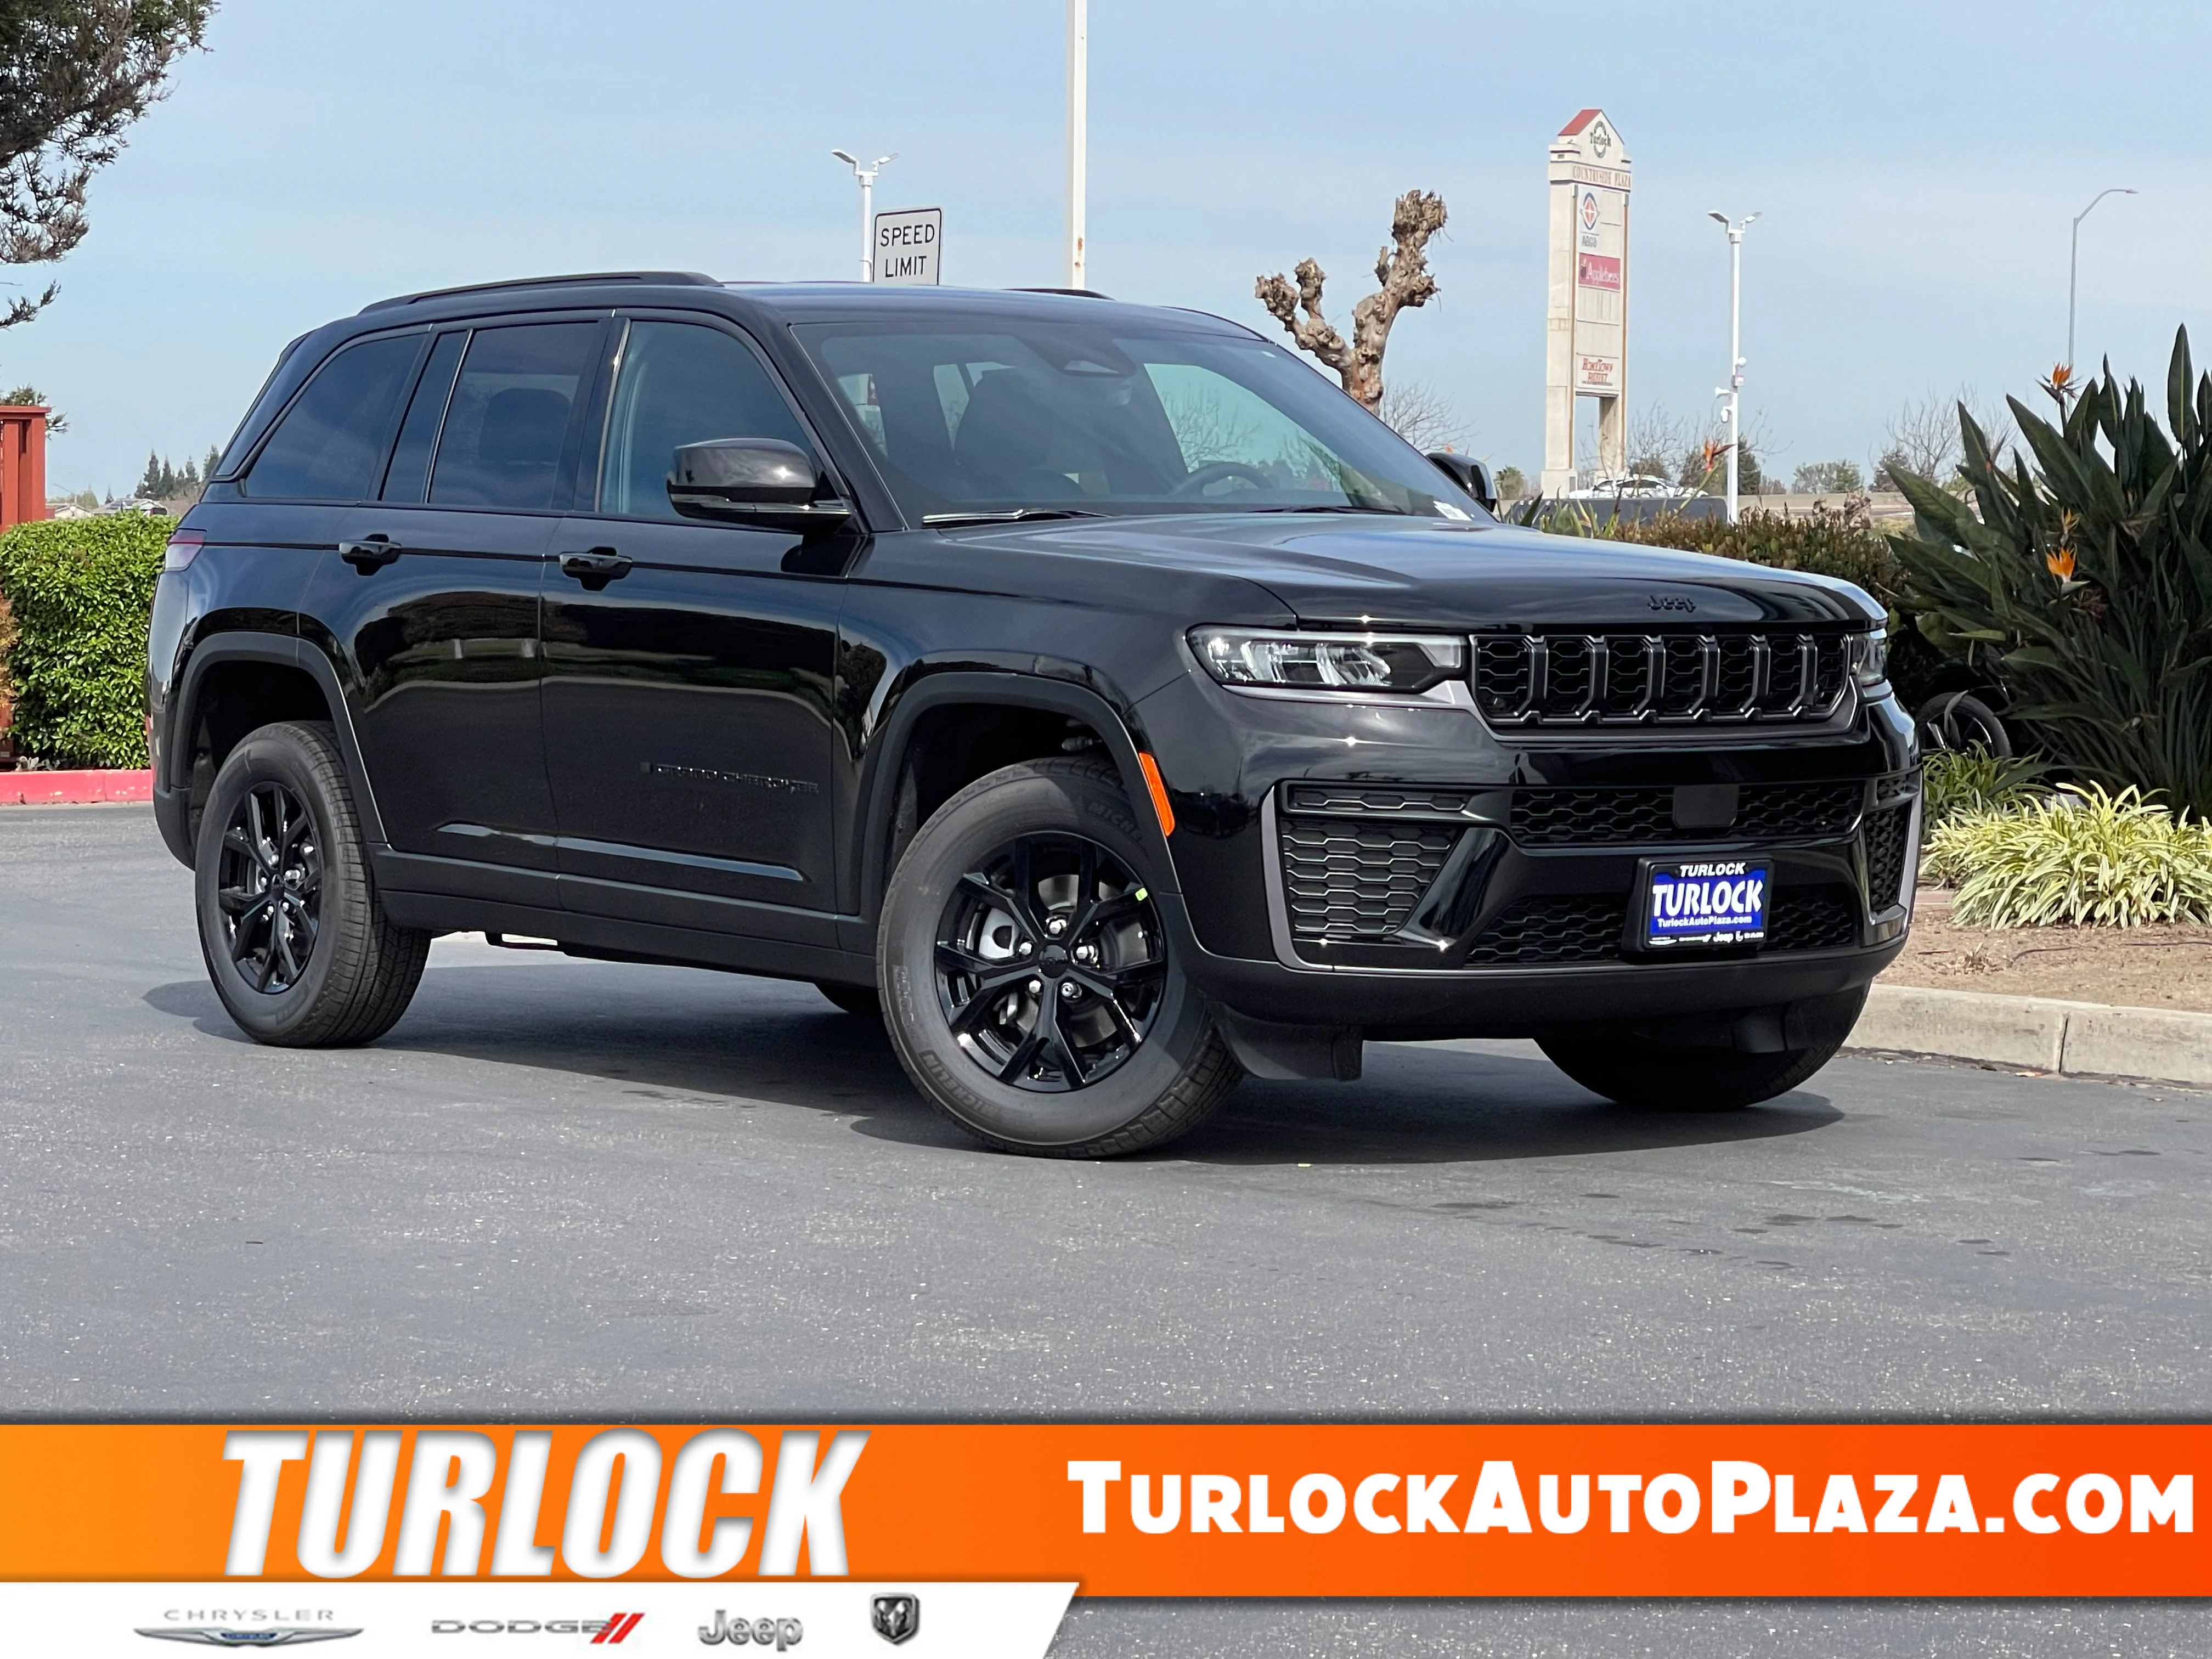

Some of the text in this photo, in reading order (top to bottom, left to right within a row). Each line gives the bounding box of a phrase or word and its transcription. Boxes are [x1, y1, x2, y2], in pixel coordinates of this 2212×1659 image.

[1615, 173, 1631, 188] PLAZA
[881, 224, 935, 247] SPEED
[885, 255, 927, 278] LIMIT
[1647, 595, 1696, 613] Jeep
[1680, 862, 1746, 877] TURLOCK
[1652, 879, 1763, 917] TURLOCK
[1657, 916, 1752, 928] TurlockAutoPlaza.com
[923, 1054, 998, 1118] MICHELIN
